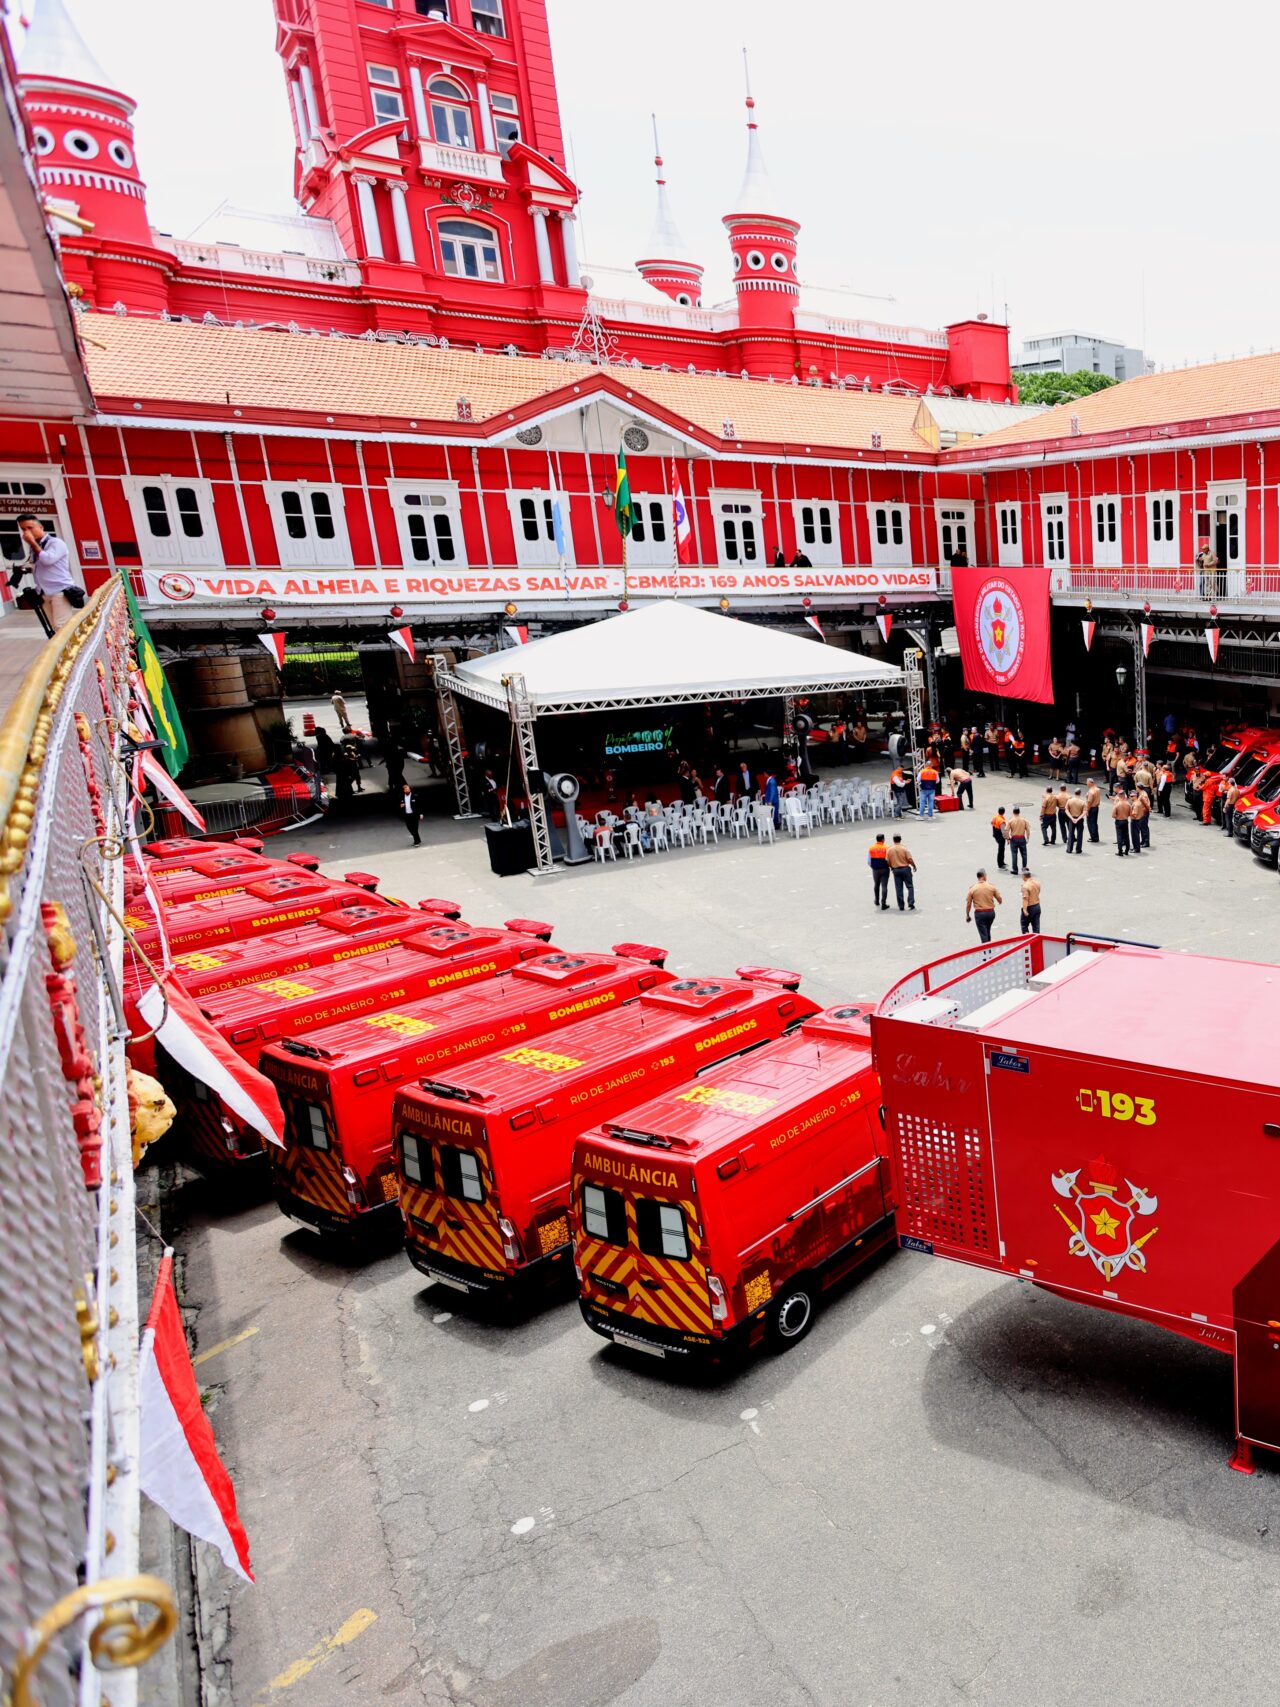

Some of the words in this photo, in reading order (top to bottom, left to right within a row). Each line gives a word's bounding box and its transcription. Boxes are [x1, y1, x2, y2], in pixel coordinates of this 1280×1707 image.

[284, 578, 379, 595] ALHEIA
[385, 578, 400, 593] E
[406, 576, 522, 596] RIQUEZAS
[709, 574, 737, 589] 169
[742, 574, 790, 588] ANOS
[794, 573, 878, 587] SALVANDO
[882, 573, 930, 586] VIDAS!
[980, 580, 997, 597] MILITAR
[1005, 583, 1021, 609] ESTADO
[605, 742, 663, 755] BOMBEIRO
[252, 907, 321, 927] BOMBEIROS
[213, 927, 231, 935] 193
[333, 938, 401, 962] BOMBEIROS
[293, 962, 310, 972] 193
[428, 961, 497, 988] BOMBEIROS
[199, 985, 218, 995] RIO
[220, 982, 234, 990] DE
[236, 971, 278, 987] JANEIRO
[389, 989, 406, 999] 193
[294, 1015, 313, 1026] RIO
[315, 1010, 330, 1021] DE
[331, 997, 375, 1016] JANEIRO
[548, 991, 616, 1021] BOMBEIROS
[510, 1022, 527, 1034] 193
[695, 1018, 757, 1052] BOMBEIROS
[415, 1055, 435, 1066] RIO
[436, 1049, 452, 1059] DE
[453, 1033, 496, 1054] JANEIRO
[659, 1055, 675, 1068] 193
[998, 1055, 1024, 1068] Labor
[570, 1092, 588, 1105] RIO
[590, 1085, 605, 1097] DE
[606, 1067, 646, 1091] JANEIRO
[846, 1090, 861, 1103] 193
[1096, 1089, 1157, 1126] 193
[401, 1103, 473, 1137] AMBULÂNCIA
[770, 1134, 787, 1149] RIO
[787, 1126, 800, 1139] DE
[800, 1105, 837, 1131] JANEIRO
[584, 1152, 678, 1188] AMBULÂNCIA
